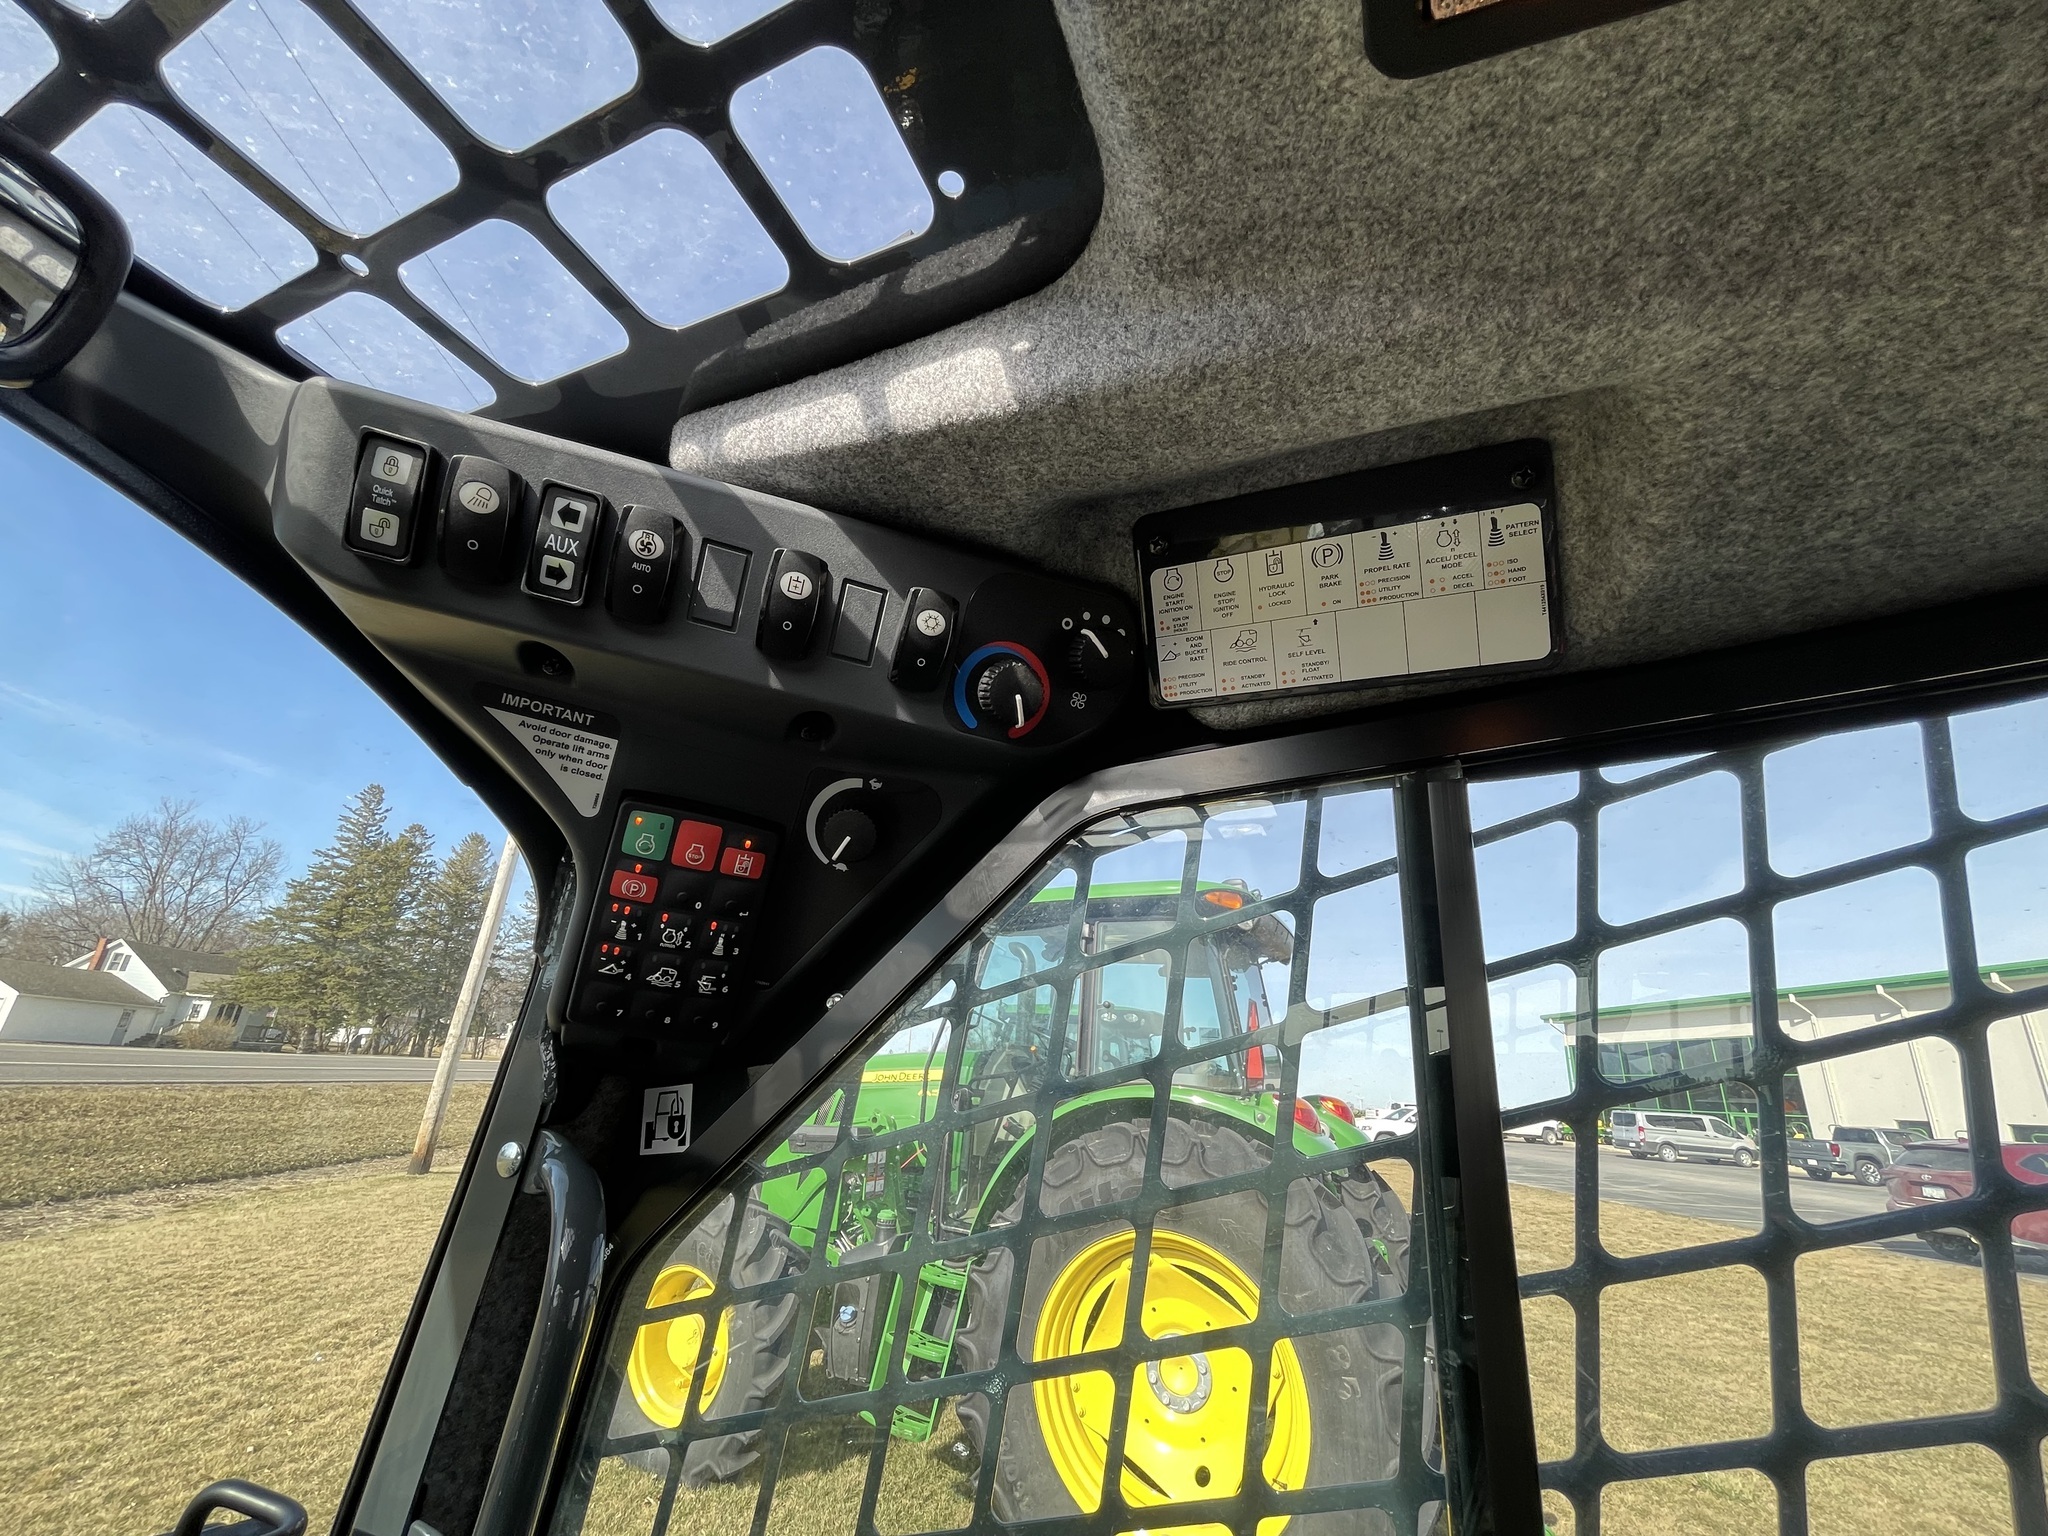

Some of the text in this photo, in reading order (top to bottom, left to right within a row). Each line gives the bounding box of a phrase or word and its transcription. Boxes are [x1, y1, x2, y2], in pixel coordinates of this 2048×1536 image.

[1506, 520, 1539, 530] PATTERN
[1509, 528, 1538, 538] SELECT
[544, 534, 580, 558] AUX
[1322, 549, 1334, 564] P
[1453, 552, 1478, 560] DECEL
[632, 562, 651, 573] AUTO
[1364, 562, 1411, 574] PROPEL RATE
[1508, 566, 1526, 574] HAND
[1321, 573, 1339, 581] PARK
[1377, 574, 1411, 584] PRECISION
[1259, 581, 1295, 592] HYDRAULIC
[1319, 580, 1343, 589] BRAKE
[1378, 585, 1401, 593] UTILITY
[1214, 591, 1236, 599] ENGINE
[1269, 590, 1286, 598] LOCK
[1379, 591, 1419, 602] PRODUCTION
[1268, 599, 1292, 608] LOCKED
[1159, 606, 1184, 614] IGNITION
[1213, 604, 1239, 613] IGNITION
[1185, 648, 1208, 656] BUCKET
[1288, 651, 1304, 659] SELF
[1223, 656, 1268, 667] RIDE CONTROL
[1178, 672, 1205, 680] PRECISION
[1303, 673, 1334, 682] ACTIVATED
[1242, 681, 1271, 689] ACTIVATED
[1180, 688, 1213, 696] PRODUCTION
[501, 692, 595, 726] IMPORTANT
[518, 720, 612, 750] Avoid door damage.
[532, 735, 610, 760] Operate lift arms
[535, 748, 608, 771] only when door
[560, 764, 603, 781] is closed.
[625, 973, 632, 981] 4
[722, 985, 729, 993] 6
[872, 1073, 898, 1082] JOHN
